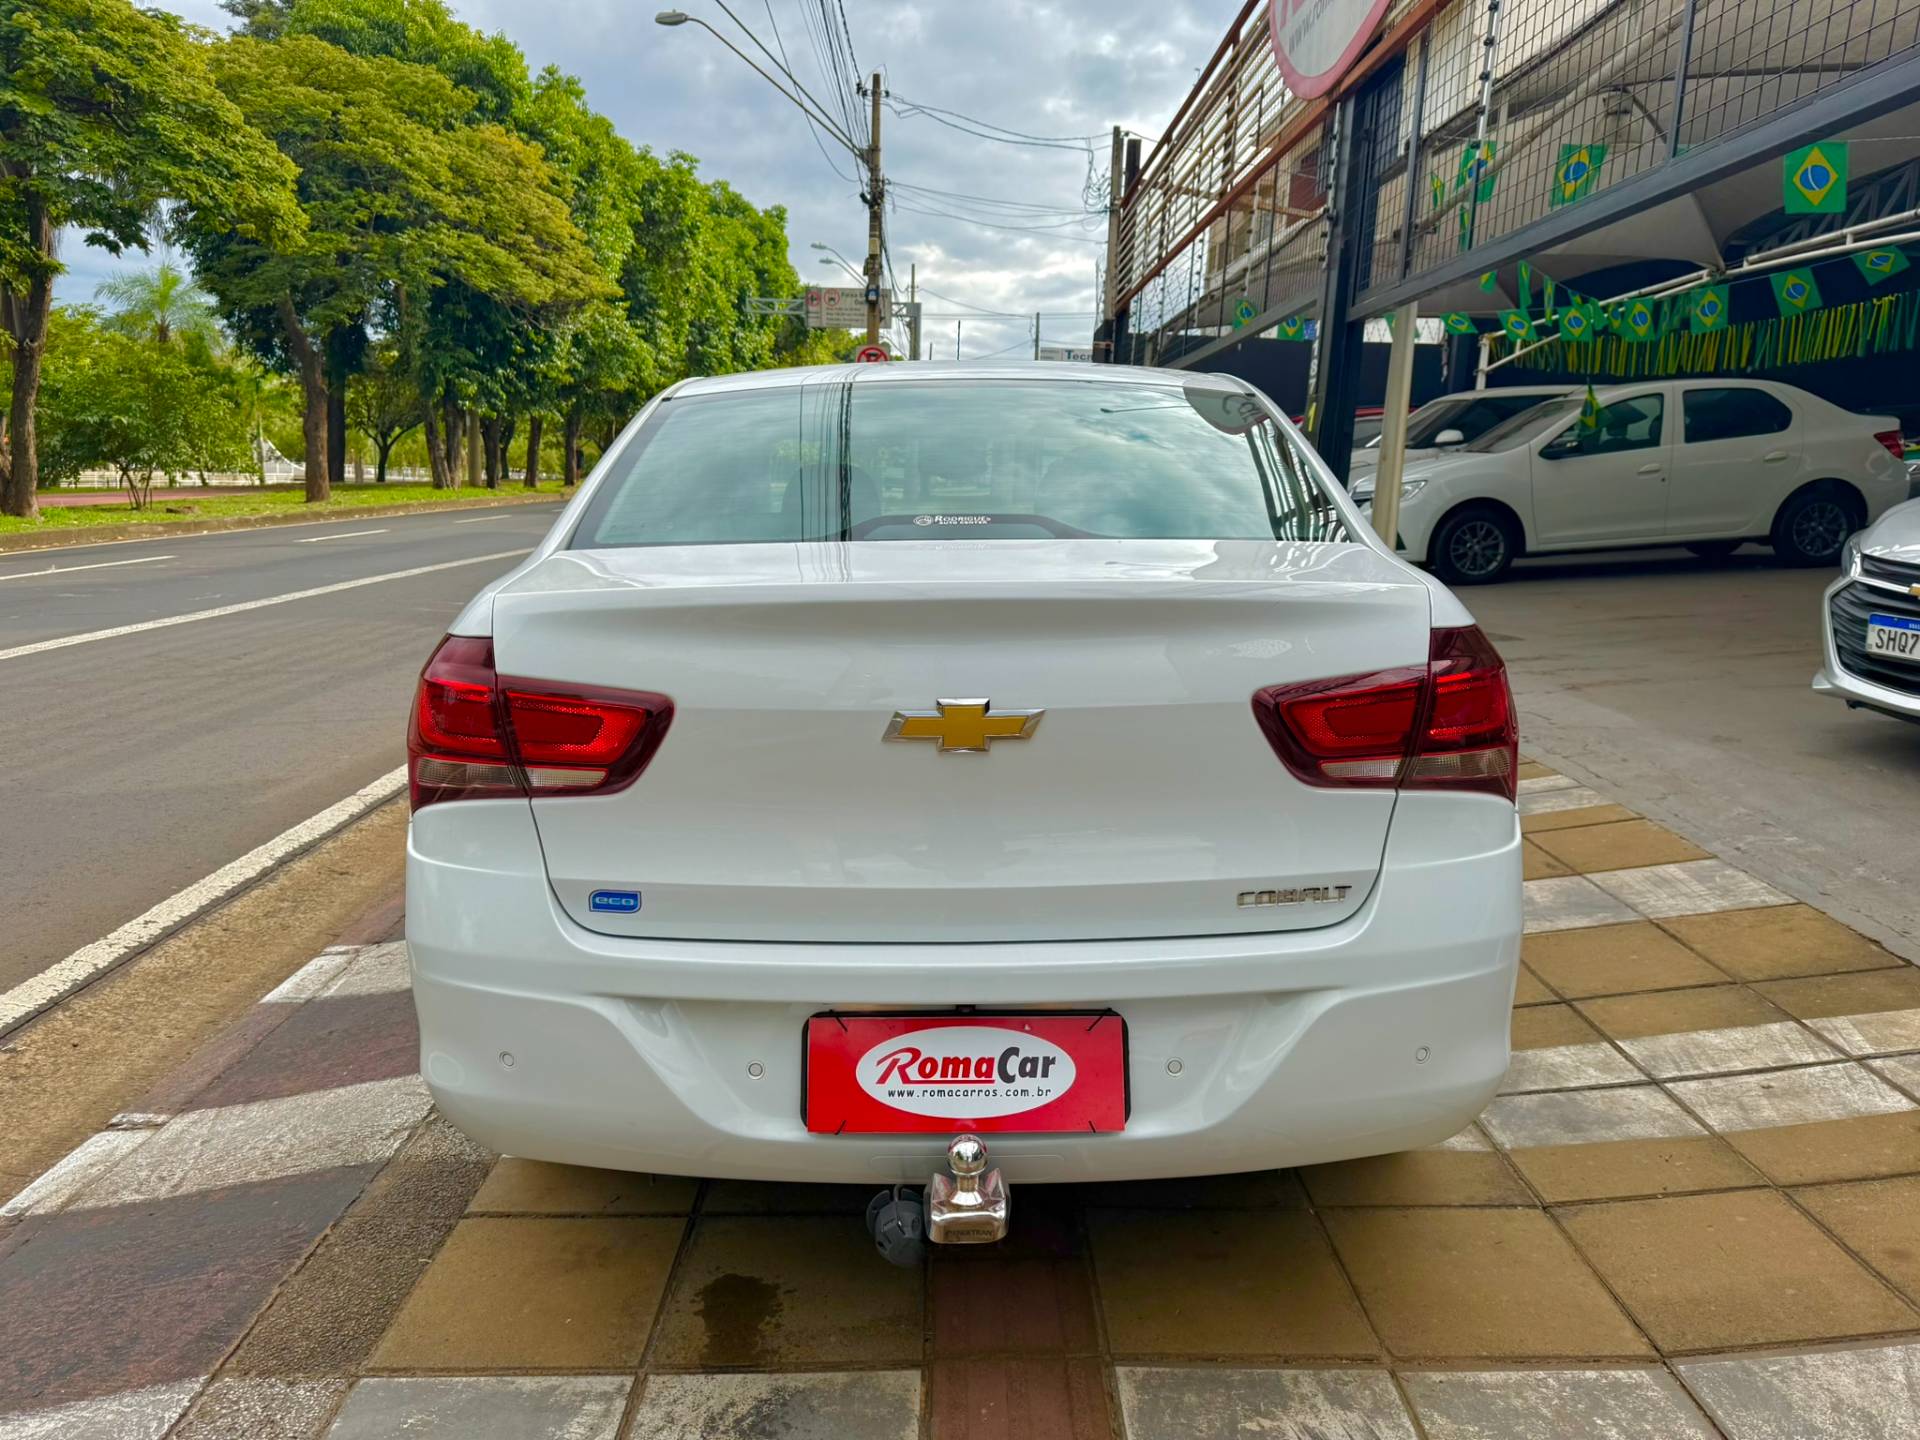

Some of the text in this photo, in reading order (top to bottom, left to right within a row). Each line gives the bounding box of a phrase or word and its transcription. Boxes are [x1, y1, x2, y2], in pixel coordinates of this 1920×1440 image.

[1237, 886, 1352, 908] COBALT
[876, 1047, 1056, 1084] RomaCar
[887, 1086, 1052, 1098] www.romacarros.com.br
